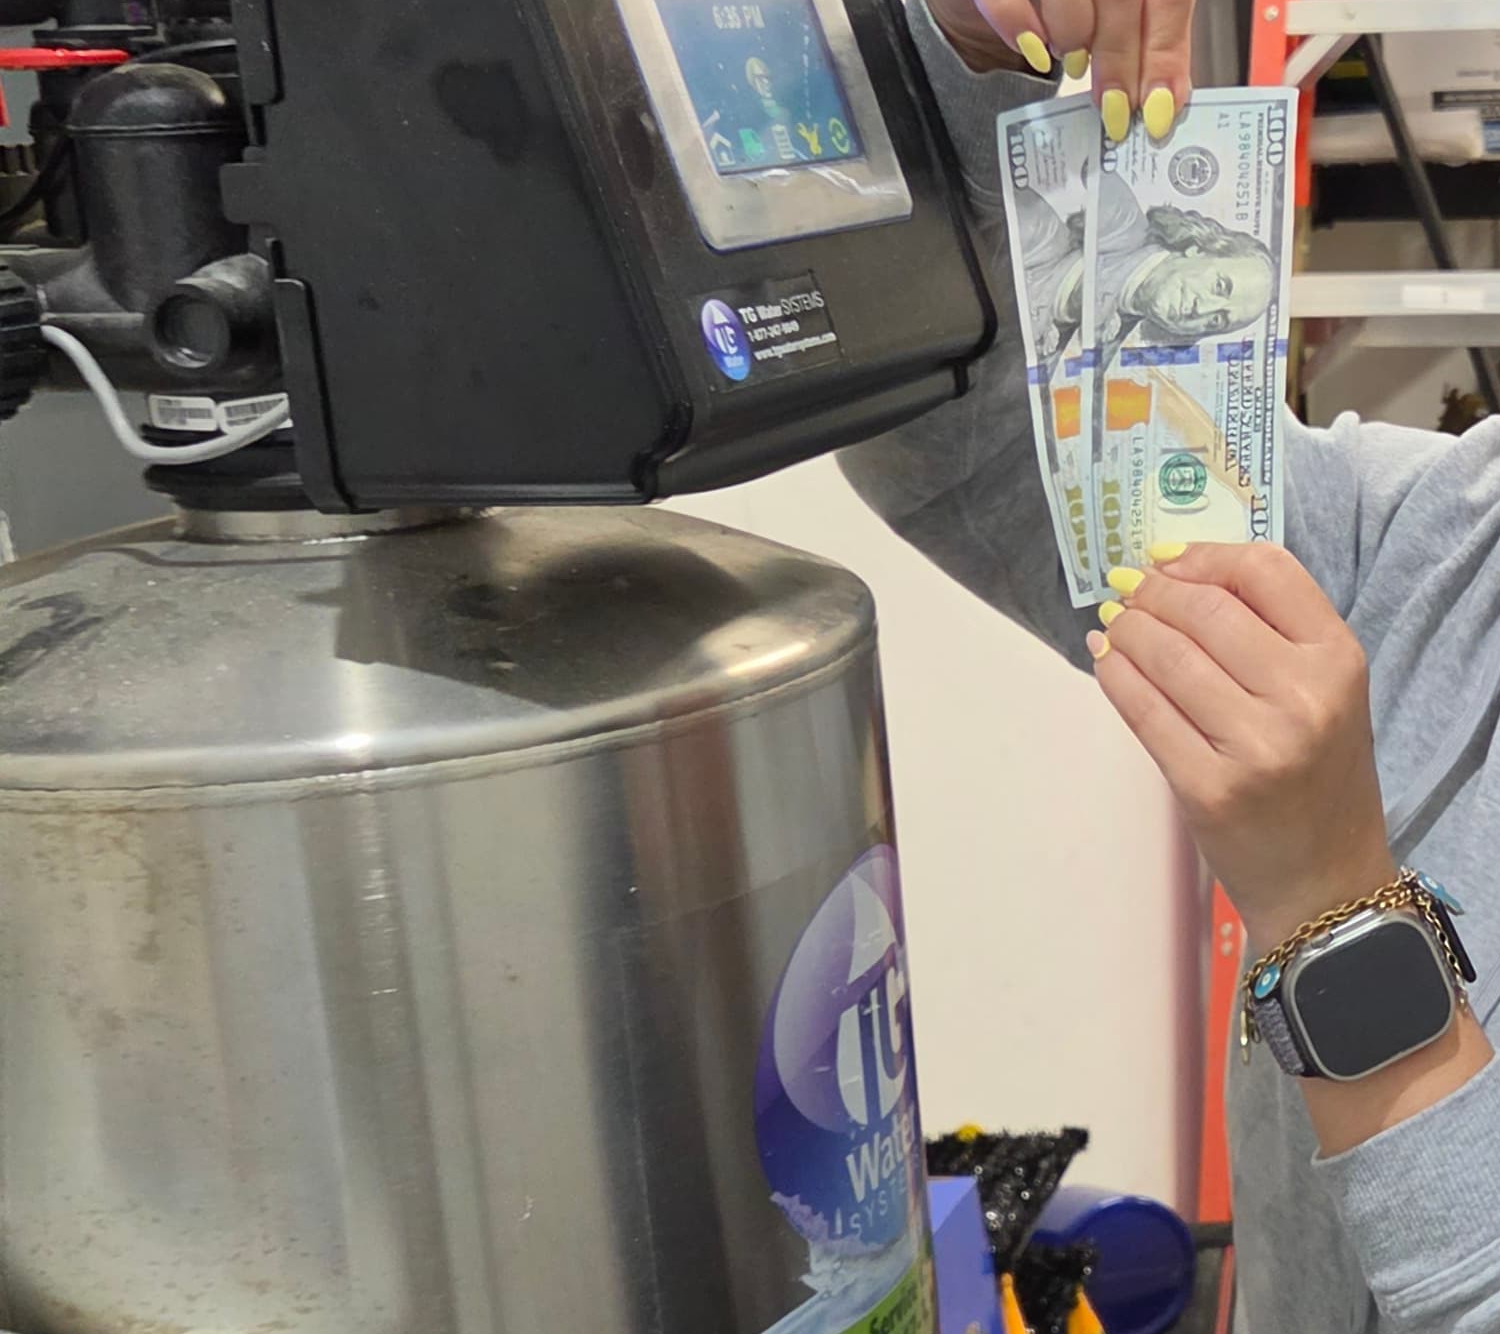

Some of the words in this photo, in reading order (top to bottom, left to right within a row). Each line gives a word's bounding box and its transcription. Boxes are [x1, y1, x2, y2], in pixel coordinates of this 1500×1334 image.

[741, 4, 766, 29] PM
[1008, 130, 1030, 189] 100
[1266, 105, 1285, 166] 100
[738, 306, 758, 324] TG
[1102, 479, 1124, 566] 100
